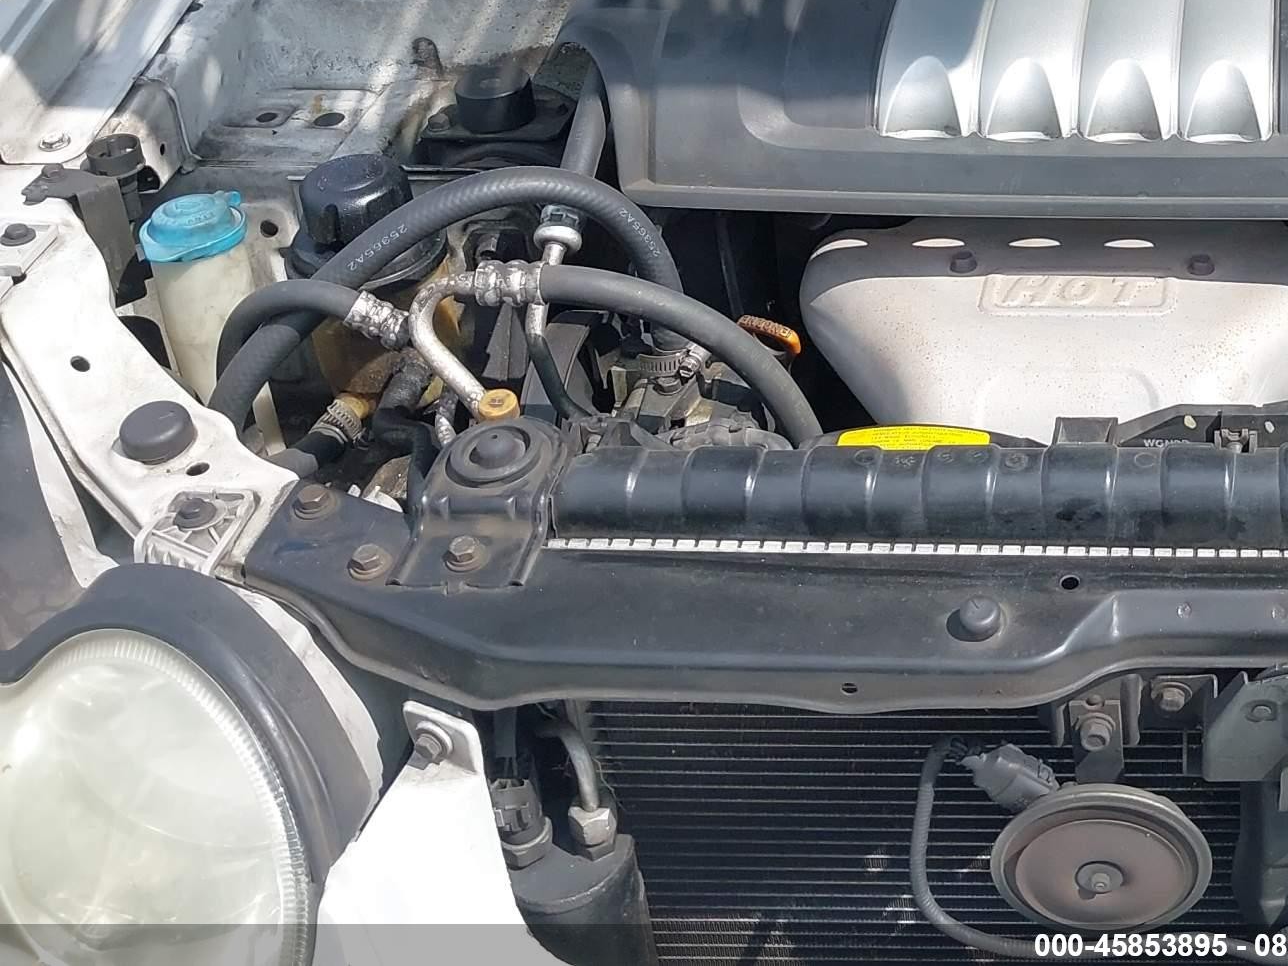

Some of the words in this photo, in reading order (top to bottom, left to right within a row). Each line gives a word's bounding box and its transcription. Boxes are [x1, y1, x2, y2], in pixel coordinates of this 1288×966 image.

[347, 223, 408, 271] 25365A2
[619, 208, 661, 257] 25365A2
[1000, 276, 1161, 306] HOT
